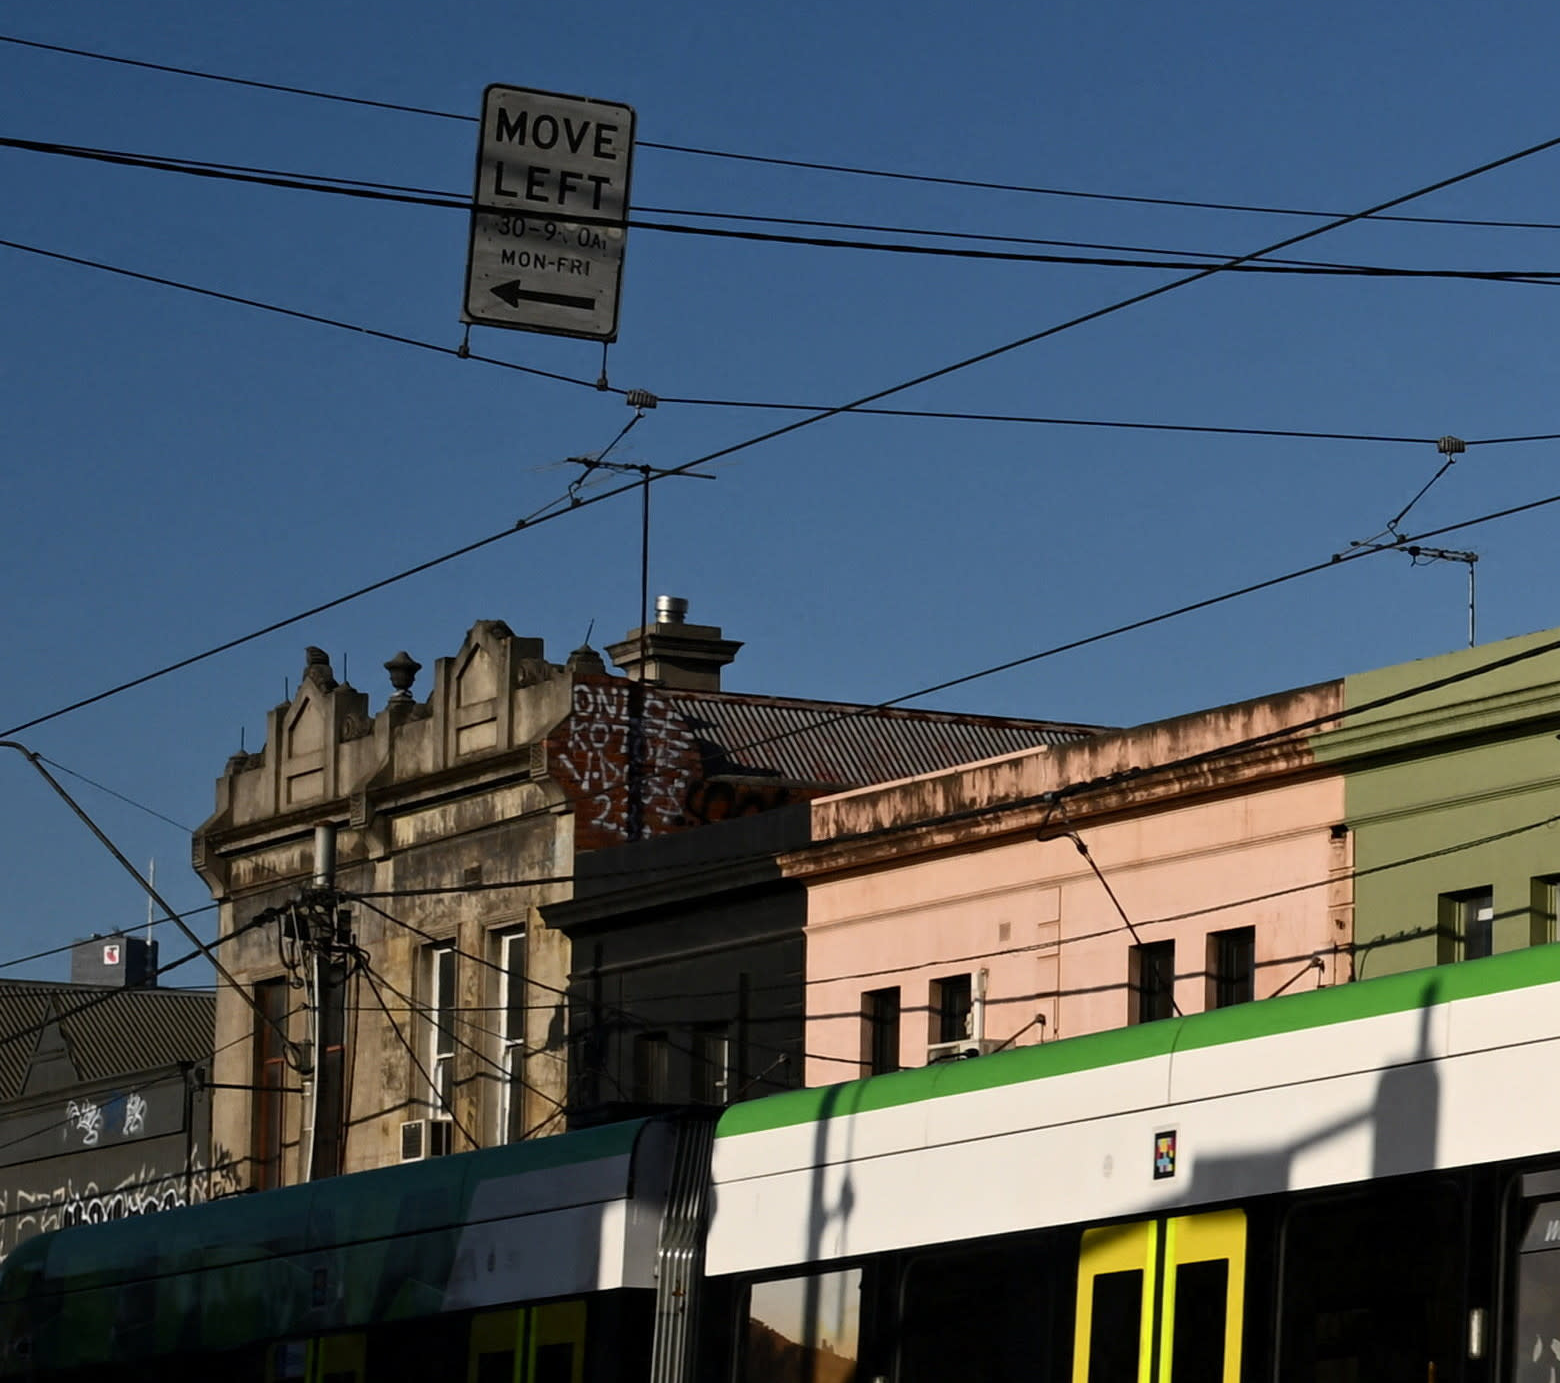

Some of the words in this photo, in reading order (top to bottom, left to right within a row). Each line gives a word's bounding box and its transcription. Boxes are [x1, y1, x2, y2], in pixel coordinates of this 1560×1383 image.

[495, 106, 619, 161] MOVE
[493, 160, 613, 211] LEFT
[501, 248, 591, 277] MON-FRI
